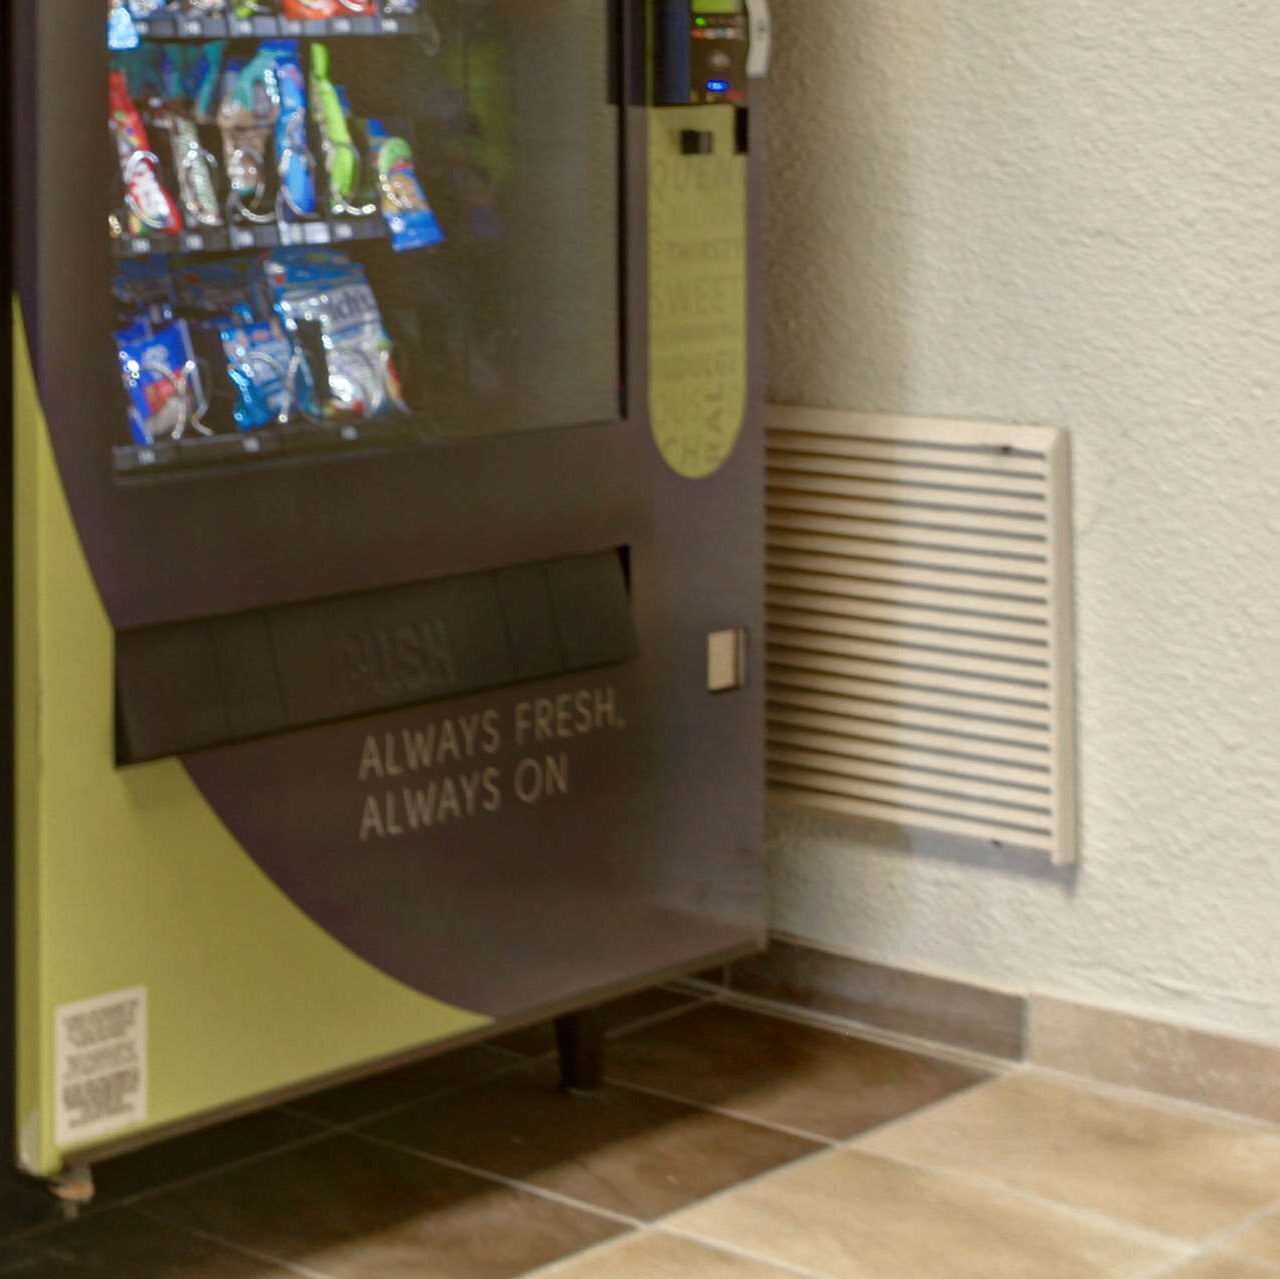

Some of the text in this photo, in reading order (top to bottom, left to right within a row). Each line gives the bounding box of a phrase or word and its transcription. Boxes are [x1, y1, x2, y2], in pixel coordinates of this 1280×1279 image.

[358, 687, 625, 781] ALWAYS FRESH.
[358, 751, 568, 842] ALWAYS ON
